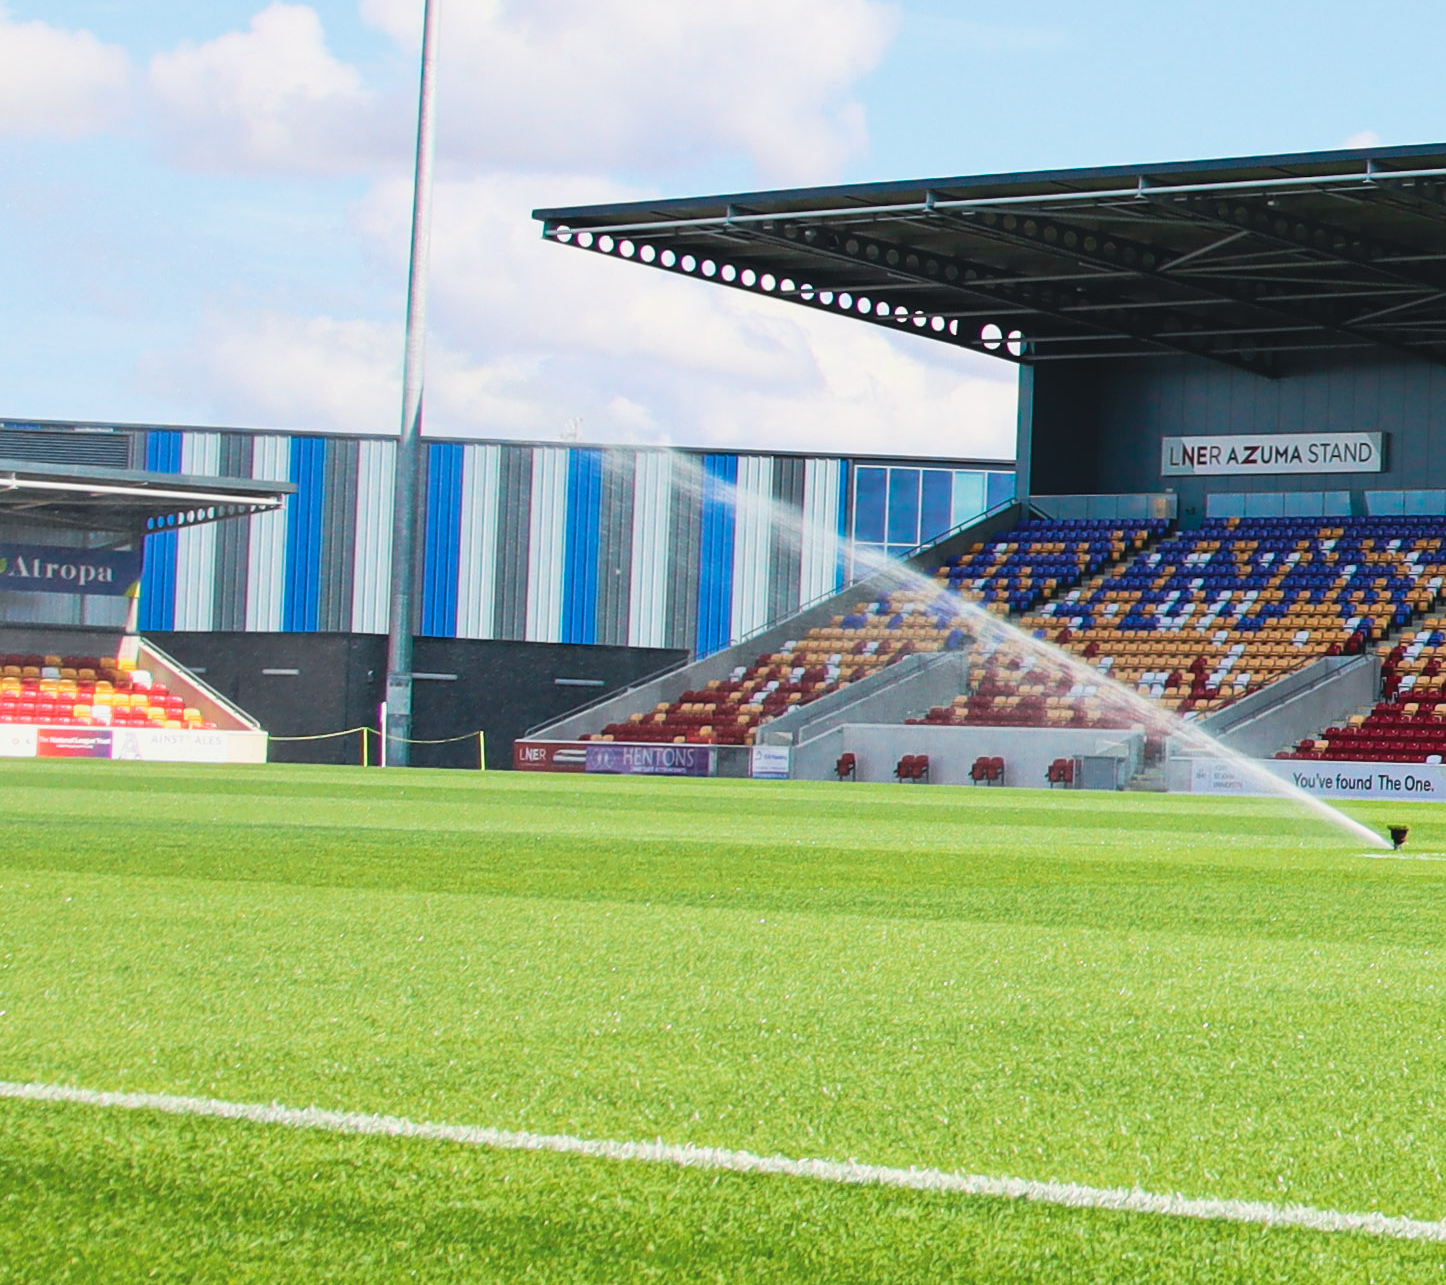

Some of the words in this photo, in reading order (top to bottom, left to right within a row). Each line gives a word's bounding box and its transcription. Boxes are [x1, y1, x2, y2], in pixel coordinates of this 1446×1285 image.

[1170, 444, 1221, 467] LNER
[1227, 445, 1302, 464] AZUMA
[1308, 443, 1372, 463] STAND
[8, 555, 113, 586] Atropa
[151, 734, 191, 745] AINST
[519, 747, 546, 761] LNER
[623, 747, 695, 767] HENTONS
[1292, 772, 1333, 789] You've
[1335, 773, 1373, 790] found
[1377, 774, 1402, 791] The
[1404, 775, 1435, 792] One.
